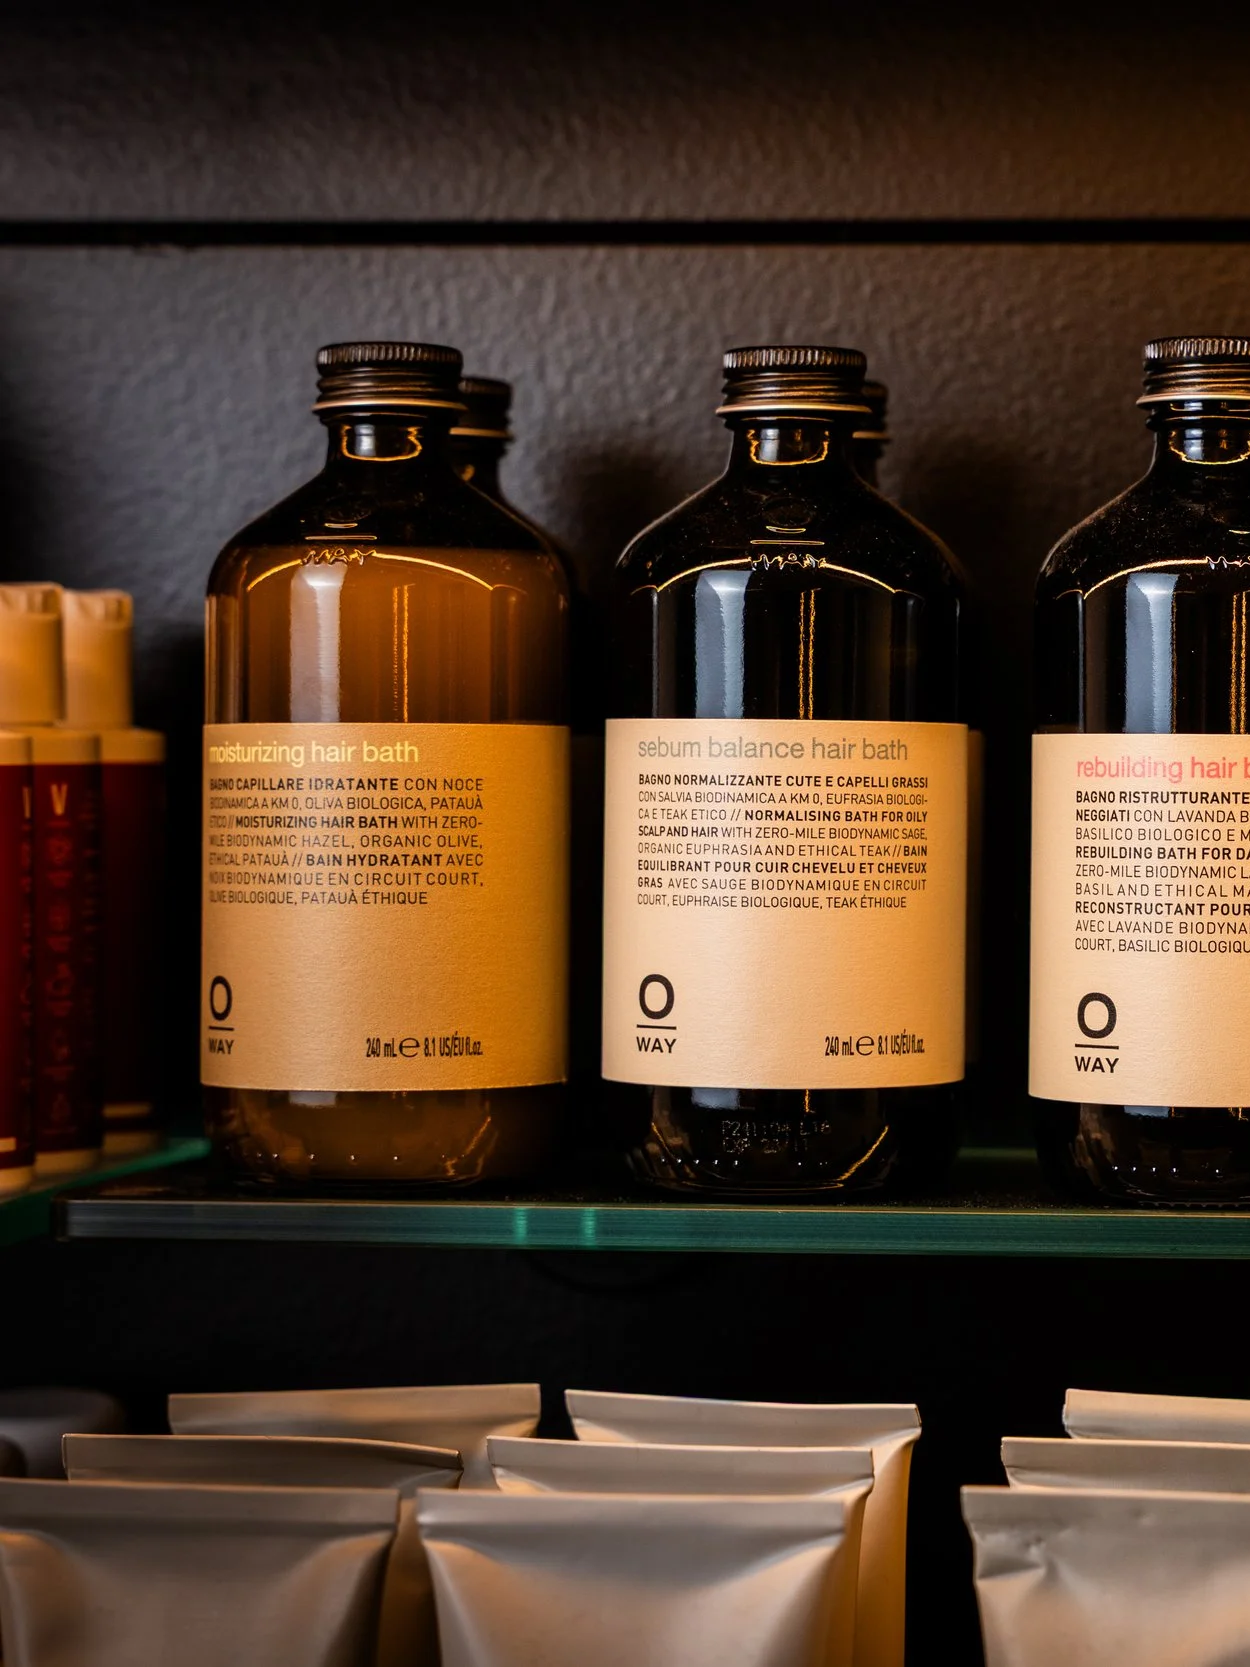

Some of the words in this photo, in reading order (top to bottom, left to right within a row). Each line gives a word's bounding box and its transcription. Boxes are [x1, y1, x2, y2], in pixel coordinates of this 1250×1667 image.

[210, 741, 305, 767] moisturizing
[312, 741, 355, 763] hair
[363, 741, 418, 763] bath
[638, 737, 700, 757] sebum
[708, 737, 804, 759] balance
[812, 738, 856, 760] hair
[863, 739, 908, 760] bath
[1077, 757, 1183, 784] rebuilding
[1191, 757, 1237, 779] hair
[210, 778, 234, 790] BAGNO
[236, 778, 304, 790] CAPILLARE
[309, 778, 398, 790] IDRATANTE
[404, 779, 437, 791] CON
[444, 779, 483, 791] NOCE
[639, 774, 671, 785] BAGNO
[674, 775, 782, 787] NORMALIZZANTE
[786, 776, 821, 787] CUTE
[826, 776, 832, 787] E
[837, 776, 889, 787] CAPELLI
[892, 777, 928, 788] GRASSI
[1076, 791, 1115, 803] BAGNO
[1119, 792, 1250, 804] RISTRUTTURANTE
[236, 816, 317, 828] MOISTURIZING
[321, 816, 355, 828] HAIR
[359, 816, 397, 828] BATH
[402, 816, 437, 829] WITH
[442, 817, 483, 829] ZERO-
[638, 860, 710, 872] EQUILIBRANT
[715, 861, 751, 873] POUR
[755, 862, 789, 873] CUIR
[792, 863, 855, 874] CHEVELU
[860, 863, 873, 874] ET
[878, 863, 927, 874] CHEVEUX
[1075, 865, 1141, 878] ZERO-MILE
[1145, 866, 1236, 878] BIODYNAMIC
[638, 894, 669, 907] COURT,
[672, 895, 737, 907] EUPHRAISE
[741, 896, 823, 909] BIOLOGIQUE,
[827, 897, 857, 908] TEAK
[860, 895, 906, 909] ÉTHIQUE
[1075, 902, 1205, 915] RECONSTRUCTANT
[1075, 939, 1115, 952] COURT,
[1119, 940, 1170, 952] BASILIC
[210, 976, 232, 1021] O
[639, 974, 675, 1019] O
[1078, 992, 1117, 1039] O
[209, 1037, 234, 1055] WAY
[366, 1037, 380, 1057] 240
[384, 1038, 397, 1058] mL
[424, 1037, 435, 1056] 8.1
[636, 1036, 677, 1053] WAY
[825, 1036, 839, 1056] 240
[841, 1036, 854, 1056] mL
[878, 1035, 888, 1055] 8.1
[1075, 1056, 1119, 1073] WAY
